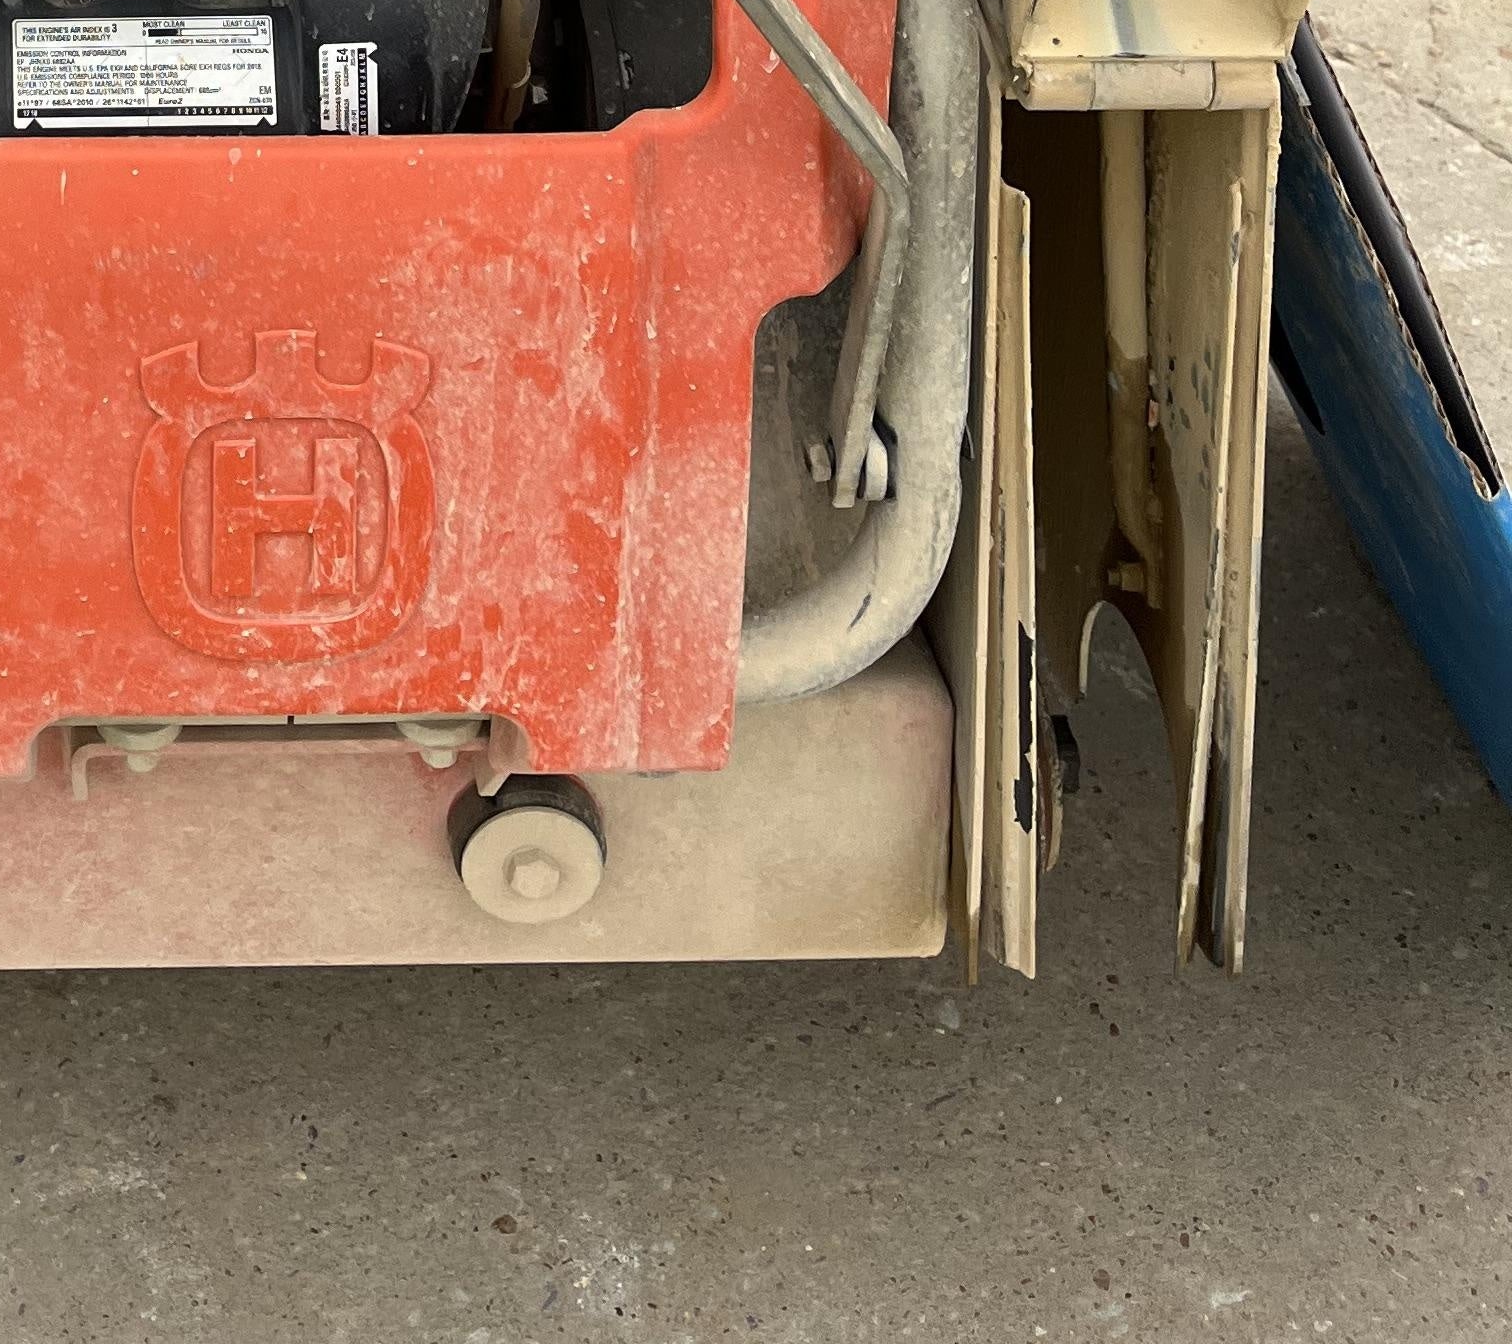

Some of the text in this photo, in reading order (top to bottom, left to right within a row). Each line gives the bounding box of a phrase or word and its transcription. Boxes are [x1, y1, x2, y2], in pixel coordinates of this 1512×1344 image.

[163, 20, 186, 28] CLEAN
[244, 19, 266, 27] CLEAN
[111, 23, 118, 33] 3
[22, 34, 35, 42] FOR
[336, 47, 349, 63] E4
